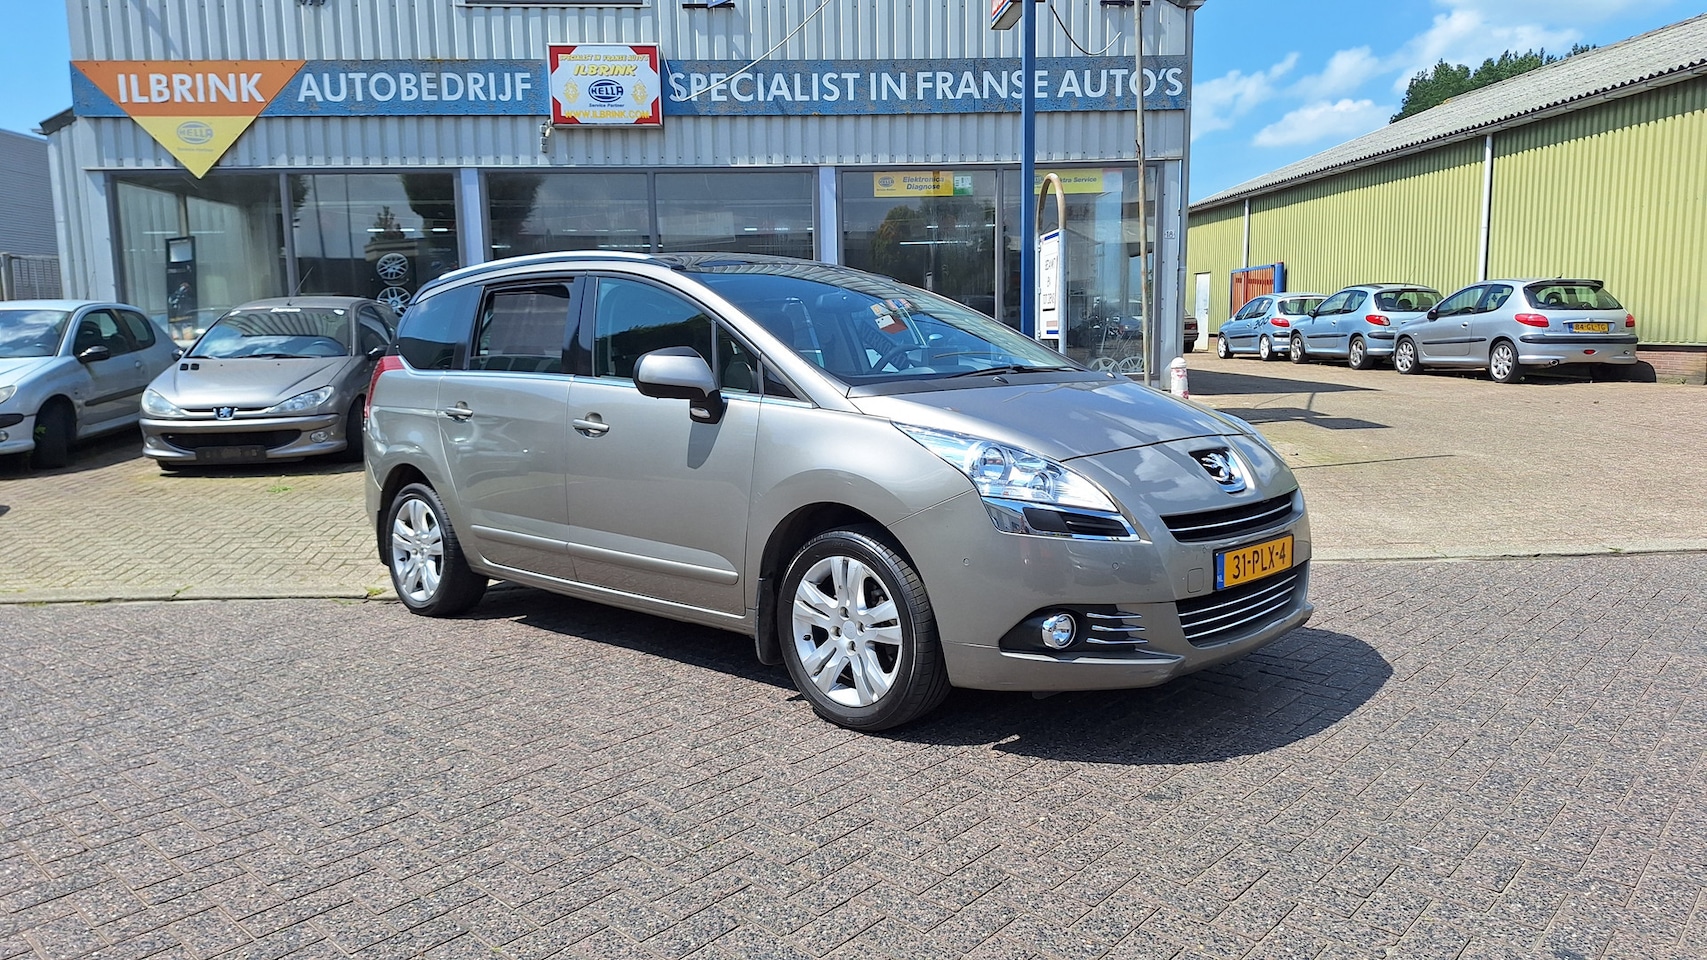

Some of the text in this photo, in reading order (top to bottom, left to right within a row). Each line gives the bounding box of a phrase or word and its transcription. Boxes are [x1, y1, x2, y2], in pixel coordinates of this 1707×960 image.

[573, 64, 638, 77] ILBRINK
[668, 67, 1184, 102] SPECIALIST IN FRANSE AUTO'S
[117, 73, 265, 103] ILBRINK
[298, 72, 531, 102] AUTOBEDRIJF
[591, 86, 624, 96] HELLA
[179, 128, 214, 139] HELLA
[1232, 542, 1286, 580] 31-PLX-4
